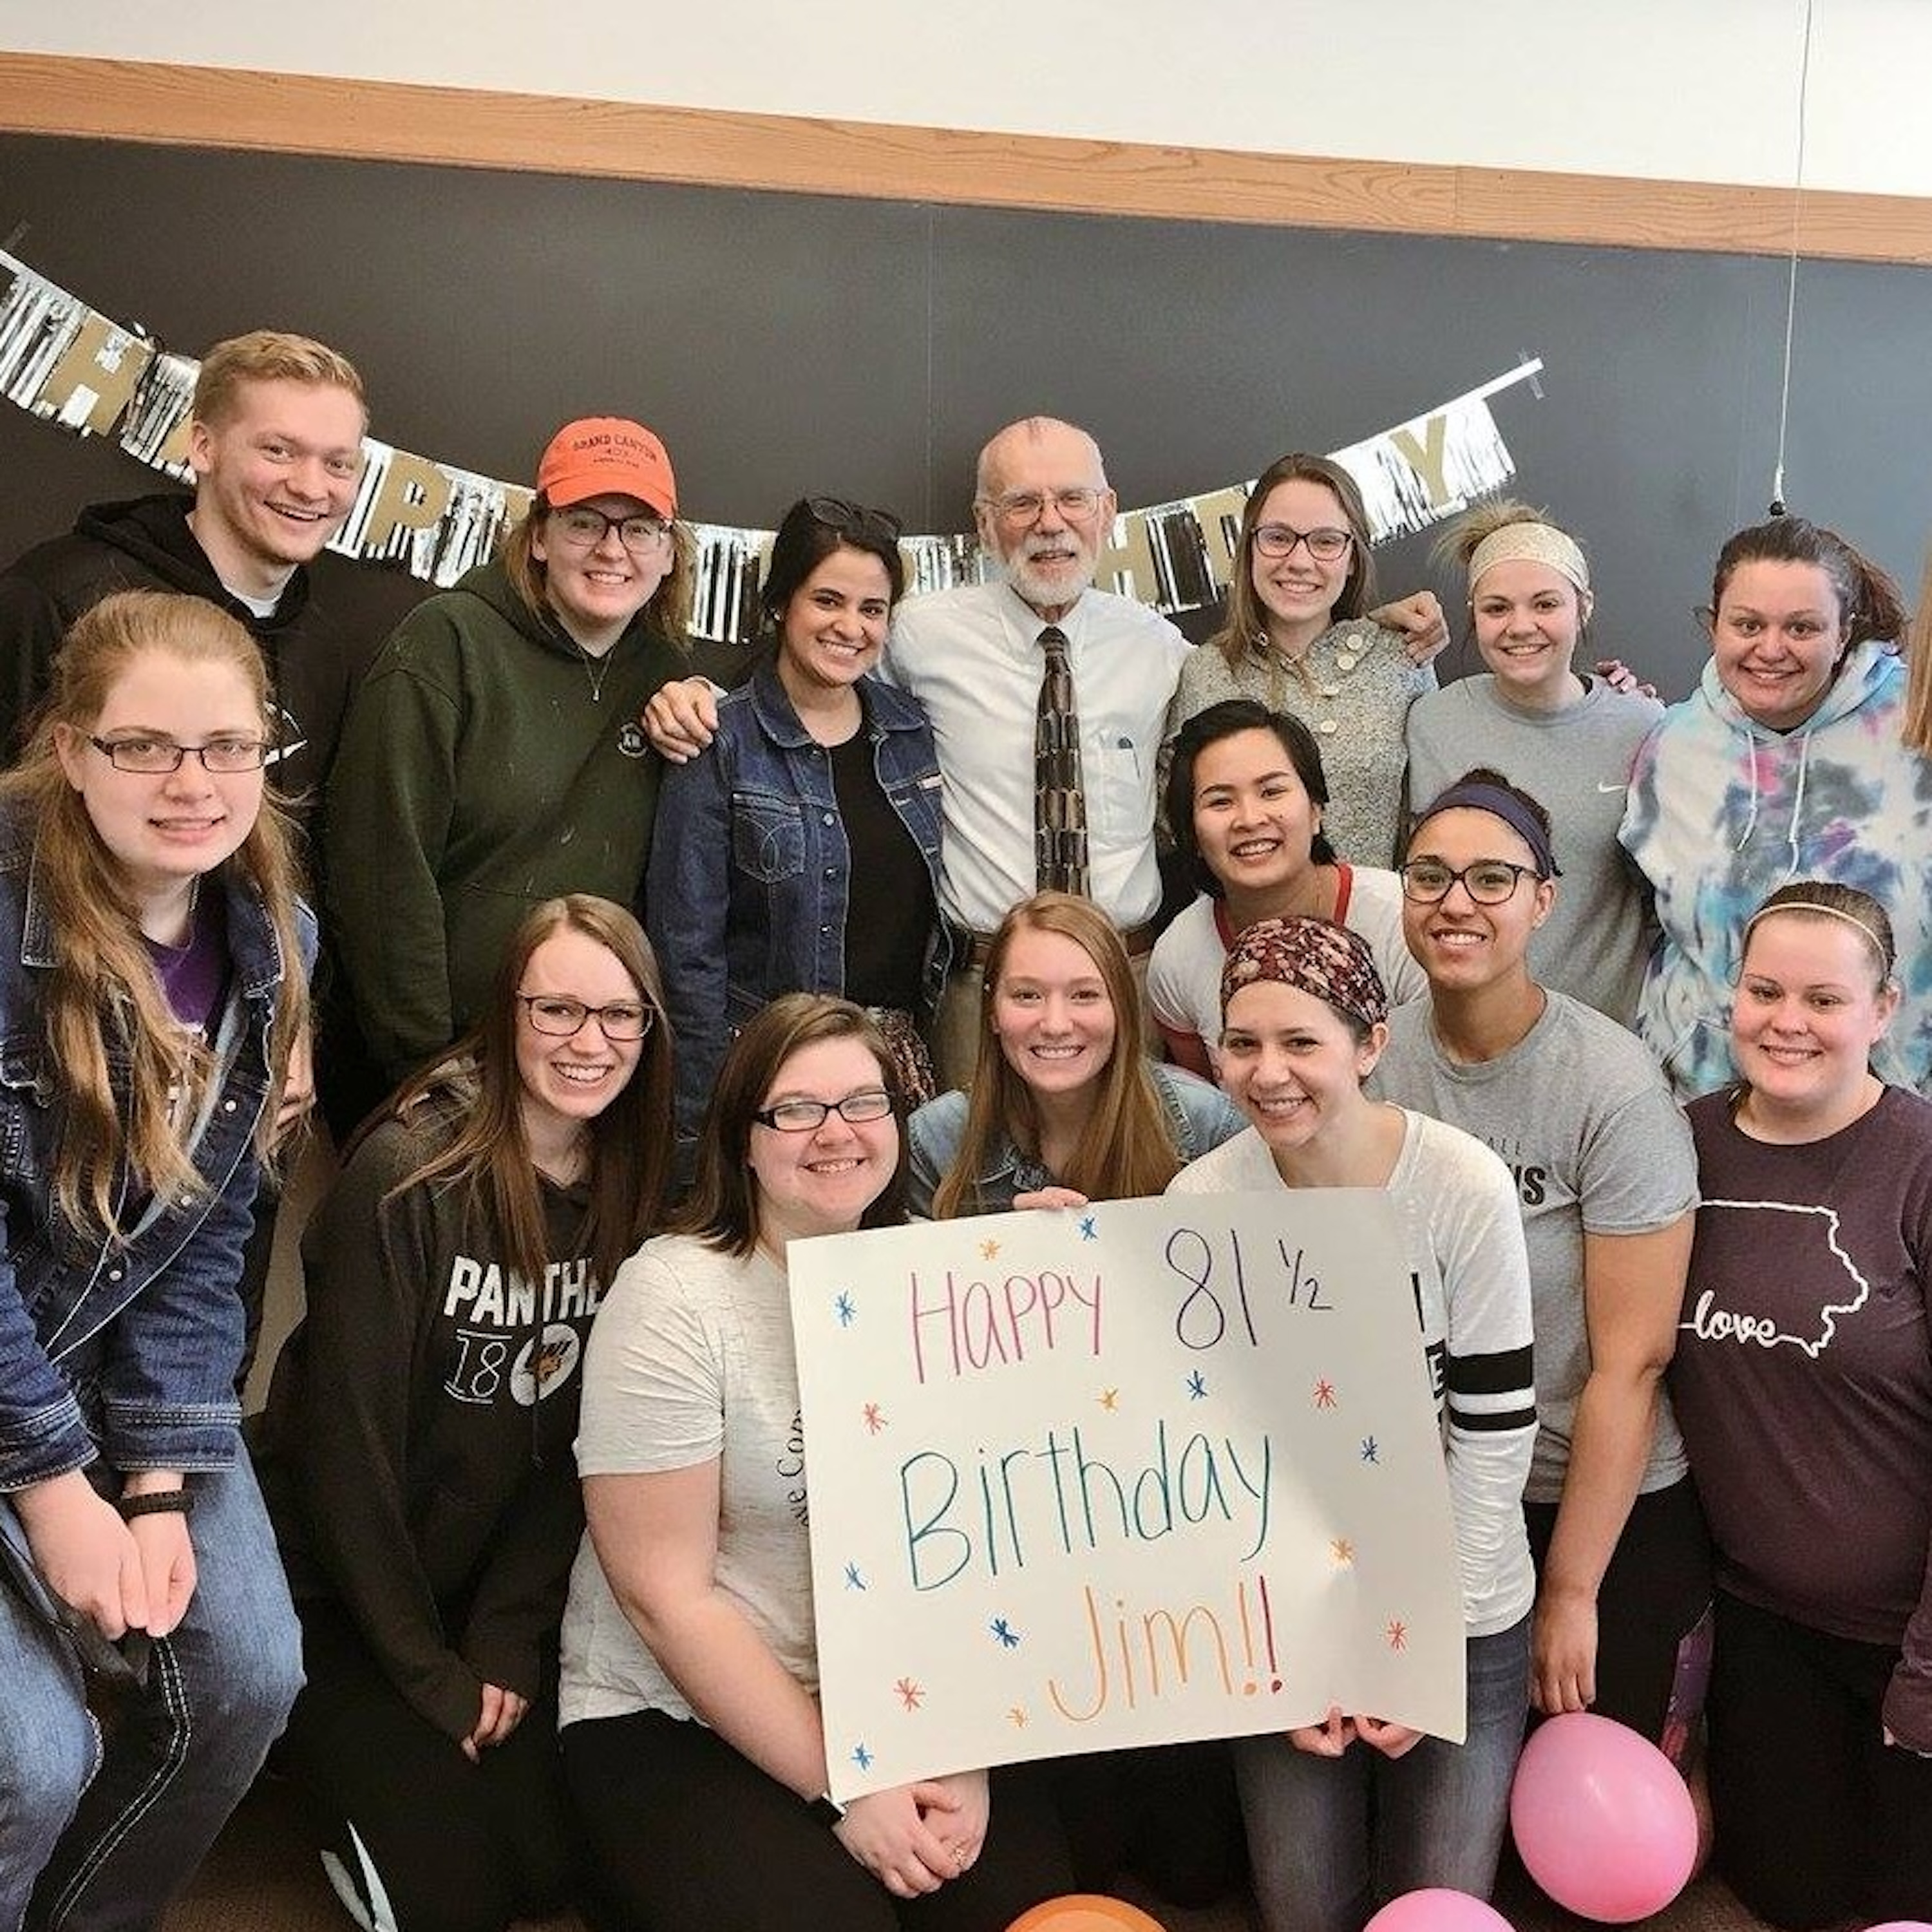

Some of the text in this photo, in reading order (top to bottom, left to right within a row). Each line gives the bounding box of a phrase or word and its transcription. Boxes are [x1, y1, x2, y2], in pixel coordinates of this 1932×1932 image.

[1166, 1227, 1256, 1350] 81
[1694, 1289, 1776, 1349] love
[902, 1419, 1269, 1591] Birthday
[1049, 1575, 1283, 1721] Jim!!
